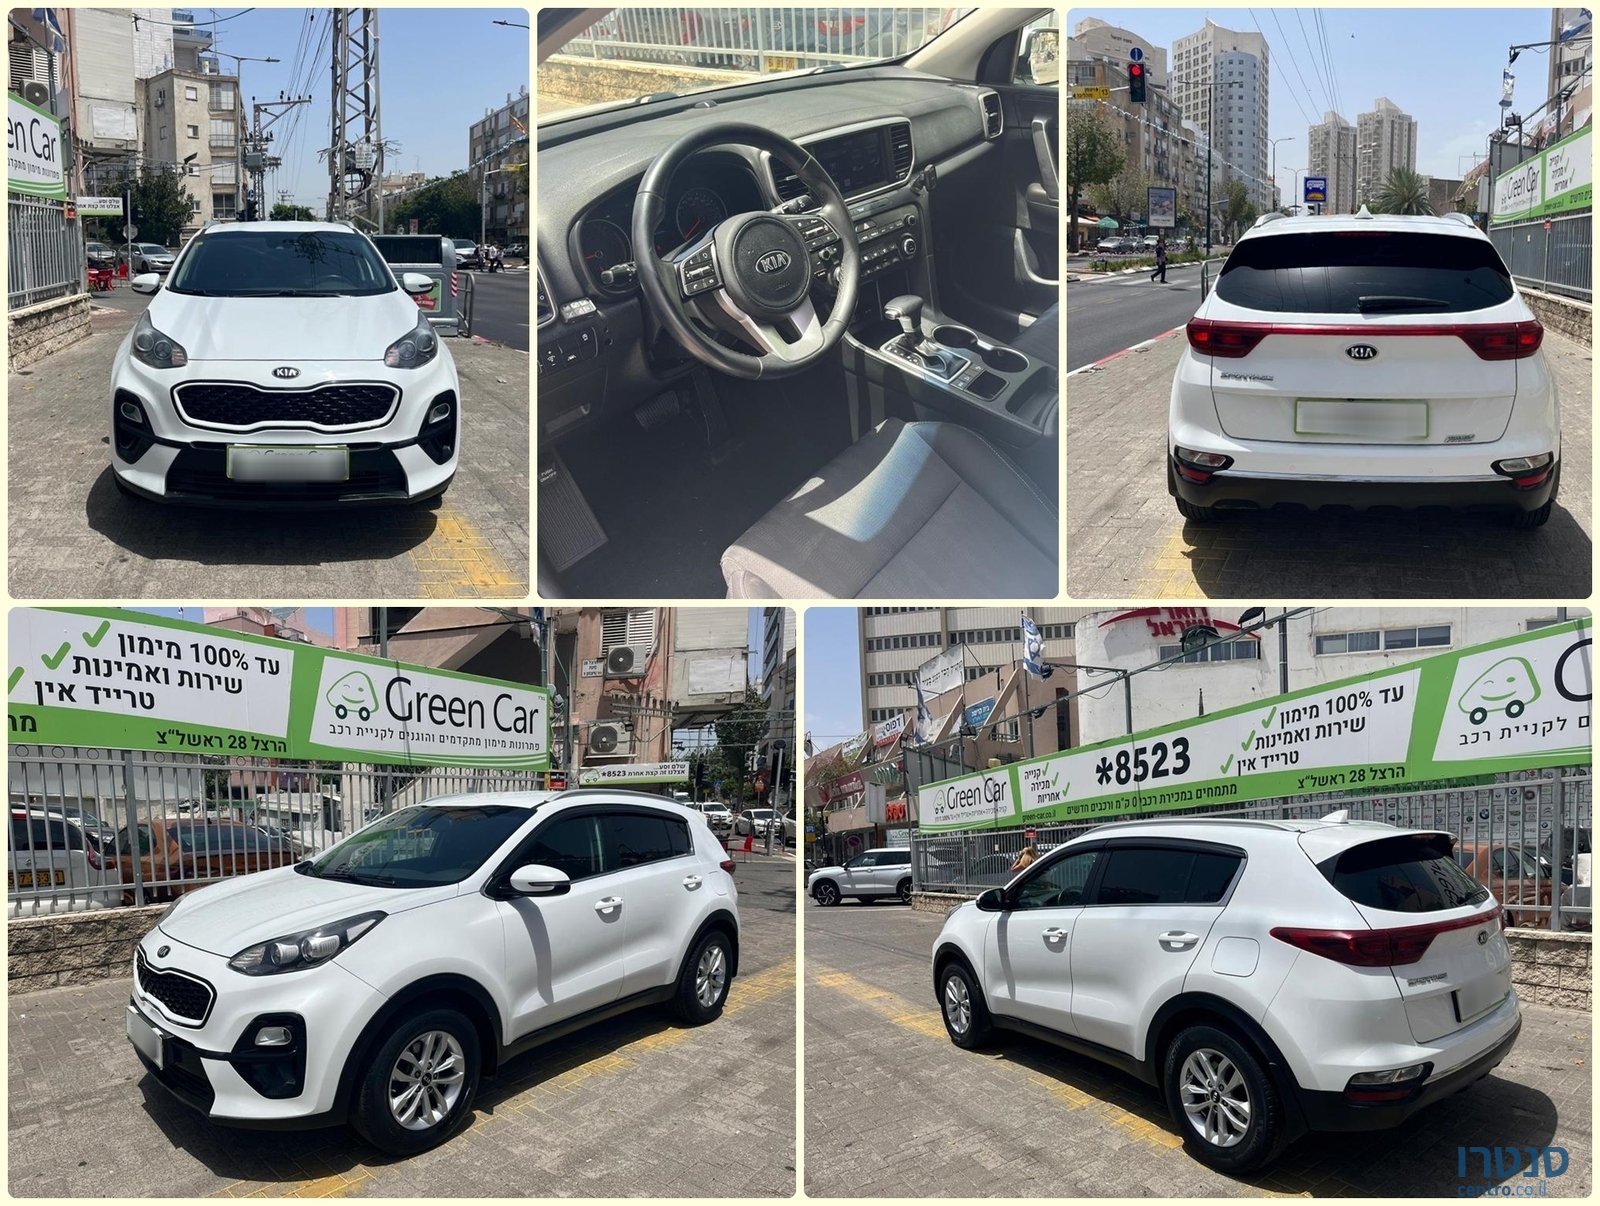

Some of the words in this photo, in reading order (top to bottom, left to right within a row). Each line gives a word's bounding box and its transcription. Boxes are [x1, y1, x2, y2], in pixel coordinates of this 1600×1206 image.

[30, 118, 56, 162] Car
[1508, 176, 1525, 200] Green
[760, 254, 787, 272] KIA
[1350, 347, 1374, 358] KIA
[276, 368, 298, 377] KIA
[118, 632, 182, 660] מימון
[190, 643, 249, 671] 100%
[72, 654, 170, 685] ואמינות
[255, 656, 280, 675] עד
[178, 670, 242, 694] שירות
[34, 680, 76, 706] אין
[86, 685, 155, 710] טרייד
[1379, 685, 1404, 704] עד
[386, 676, 484, 730] Green
[494, 694, 538, 734] Car
[1325, 691, 1372, 716] 100%
[886, 718, 900, 732] דפוס
[1280, 704, 1320, 730] מימון
[330, 724, 351, 736] רכב
[356, 727, 394, 740] לקניית
[1314, 716, 1366, 740] שירות
[1500, 716, 1567, 739] לקניית
[228, 734, 248, 750] 28
[251, 736, 287, 753] הרצל
[399, 730, 435, 743] והוגנים
[439, 734, 481, 747] מתקדמים
[484, 738, 506, 749] מימון
[1255, 728, 1310, 750] ואמינות
[1459, 730, 1491, 746] רכב
[509, 739, 540, 751] פתרונות
[1237, 758, 1256, 777] אין
[1260, 750, 1299, 770] טרייד
[1024, 768, 1041, 780] קנייה
[1349, 769, 1366, 783] 28
[1370, 765, 1405, 781] הרצל
[947, 786, 981, 810] Green
[984, 777, 1006, 803] Car
[1031, 780, 1050, 792] מכירה
[1196, 783, 1237, 799] מתמחים
[1038, 791, 1060, 804] אחריות
[1132, 796, 1137, 808] 0
[1160, 790, 1192, 804] במכירת
[1067, 804, 1088, 815] חדשים
[1090, 802, 1114, 812] ורכבים
